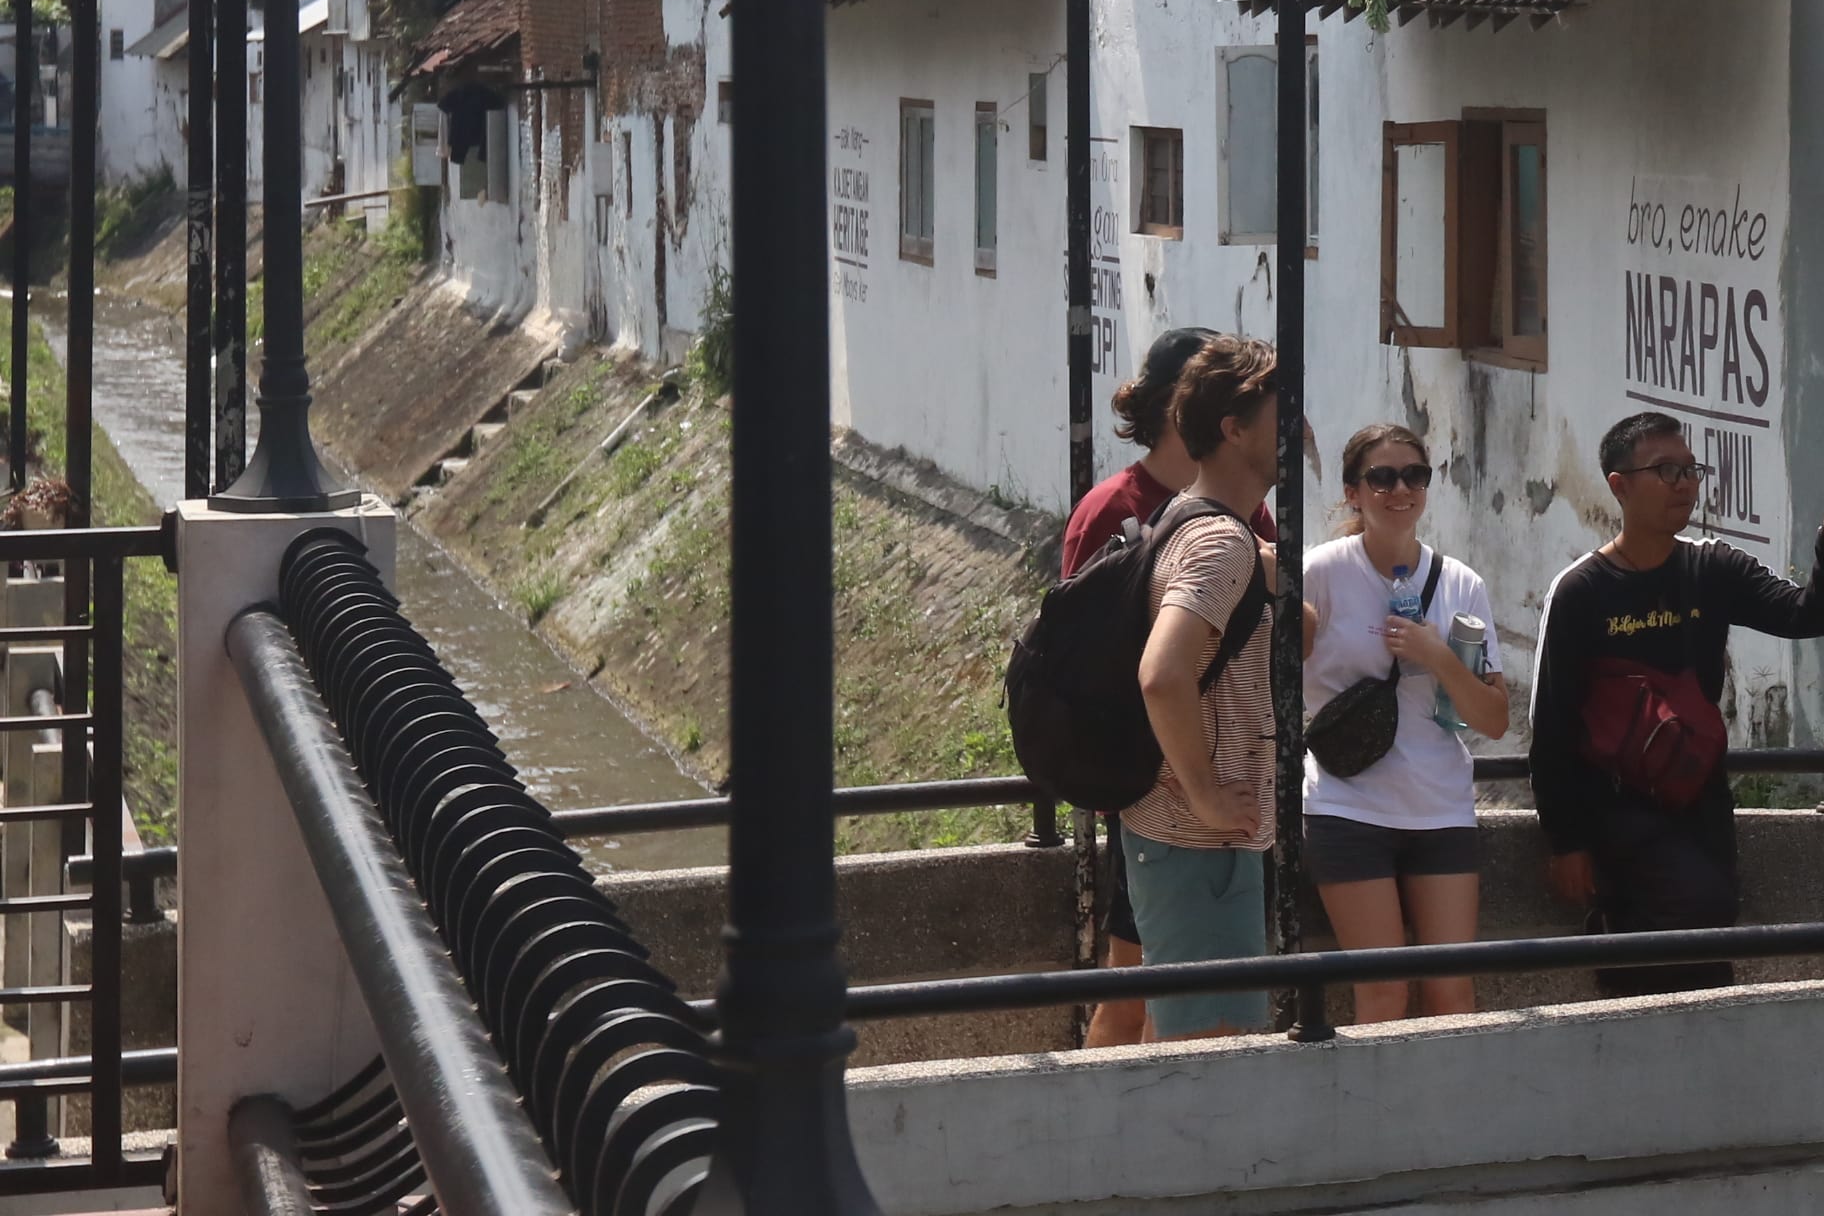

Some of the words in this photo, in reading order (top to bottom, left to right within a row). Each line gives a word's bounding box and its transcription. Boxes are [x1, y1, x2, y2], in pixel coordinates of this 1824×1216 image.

[834, 204, 869, 257] HERITAGE
[1627, 175, 1673, 255] bro,
[1679, 183, 1768, 262] enake
[1091, 267, 1121, 311] ENTING
[1091, 315, 1117, 378] OPI
[1625, 269, 1770, 408] NARAPAS
